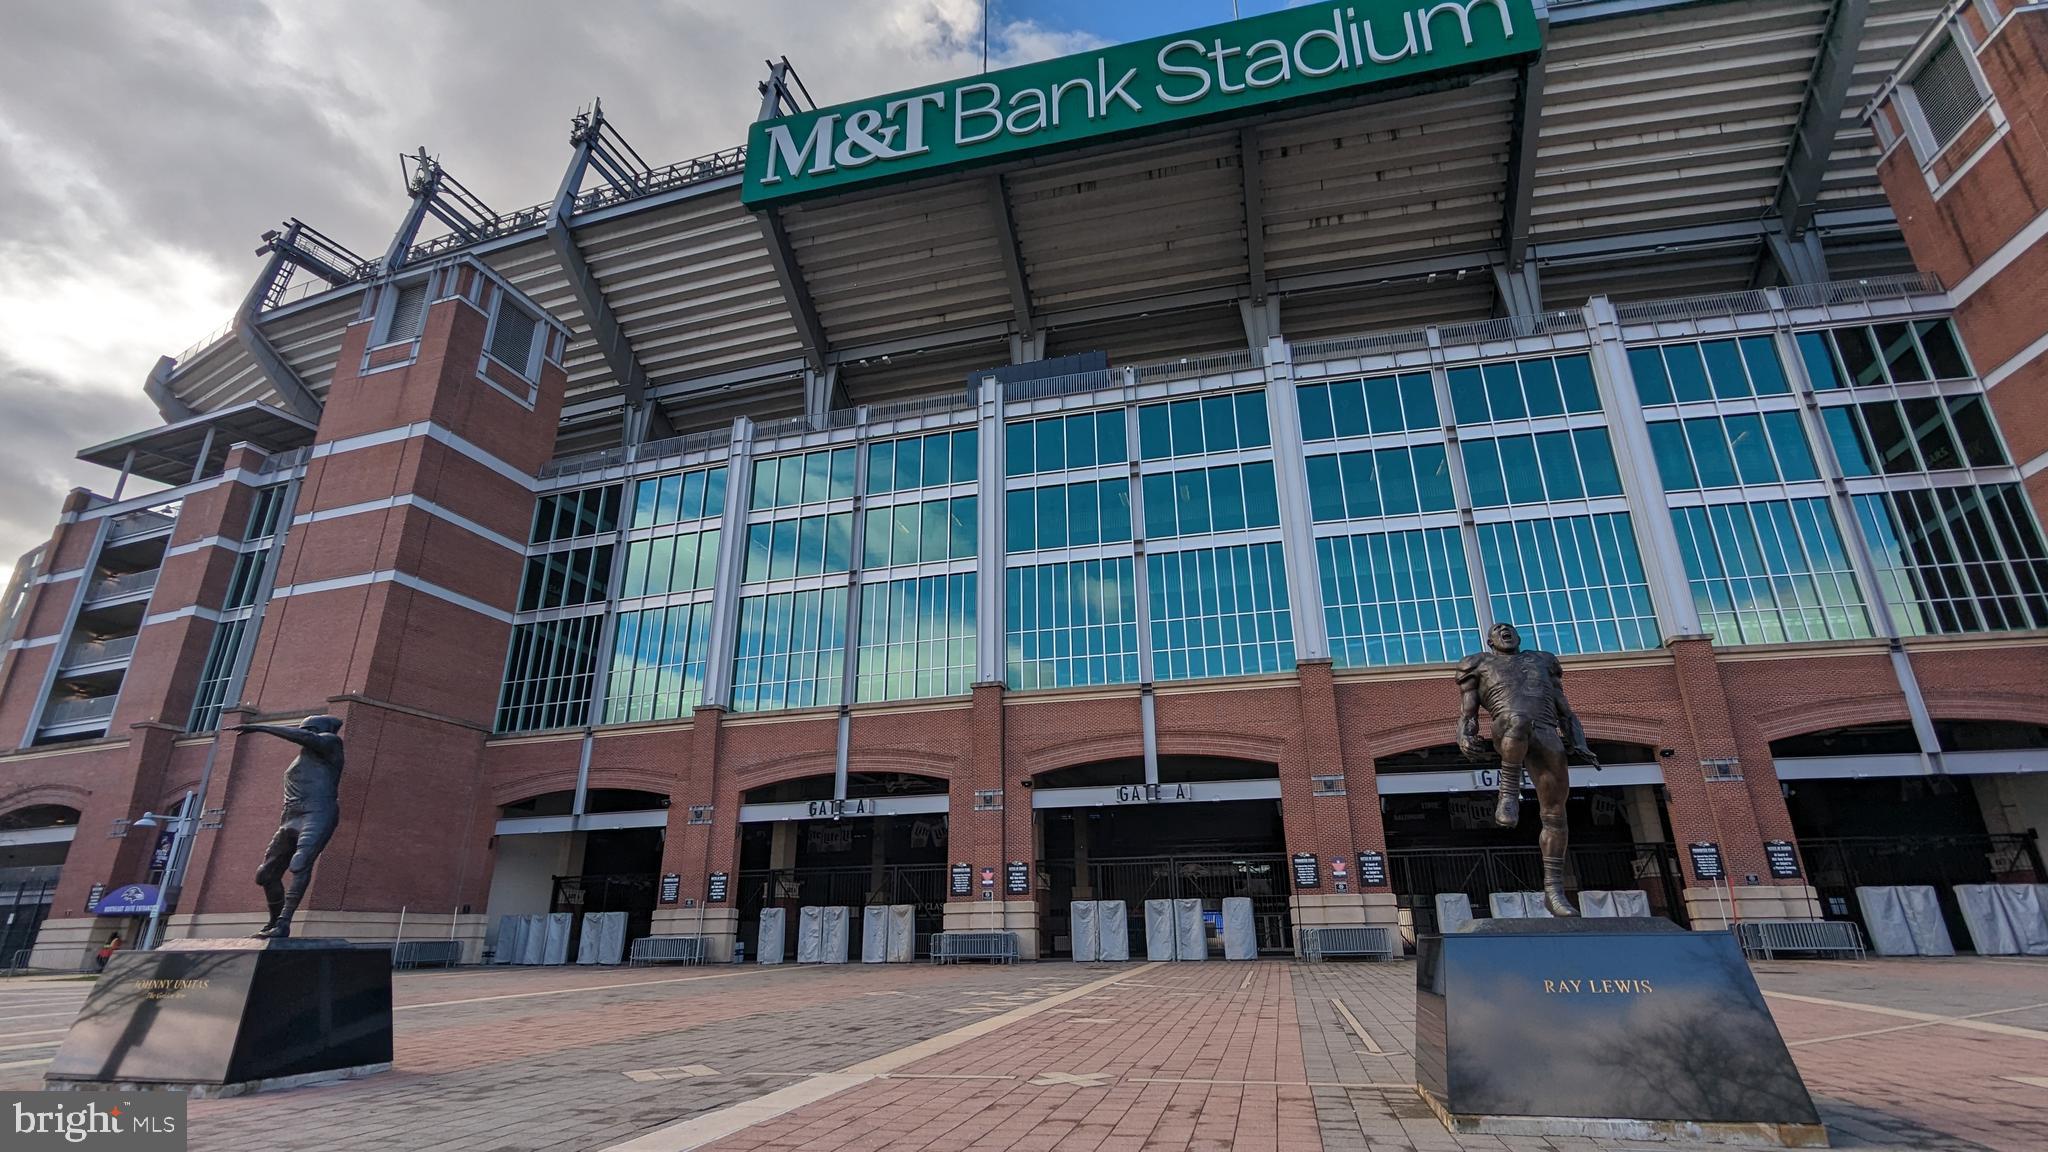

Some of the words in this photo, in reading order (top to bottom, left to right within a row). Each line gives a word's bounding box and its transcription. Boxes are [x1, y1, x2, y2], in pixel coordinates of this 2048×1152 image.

[760, 91, 945, 186] M&T
[954, 57, 1142, 146] Bank
[1155, 0, 1514, 105] Stadium
[1120, 784, 1161, 802] GATE
[1176, 783, 1185, 800] A
[809, 801, 846, 817] GATE
[857, 800, 865, 814] A
[135, 980, 173, 989] JOHNNY
[174, 980, 209, 989] UNITAS
[1544, 980, 1581, 993] RAY
[1588, 980, 1653, 993] LEWIS
